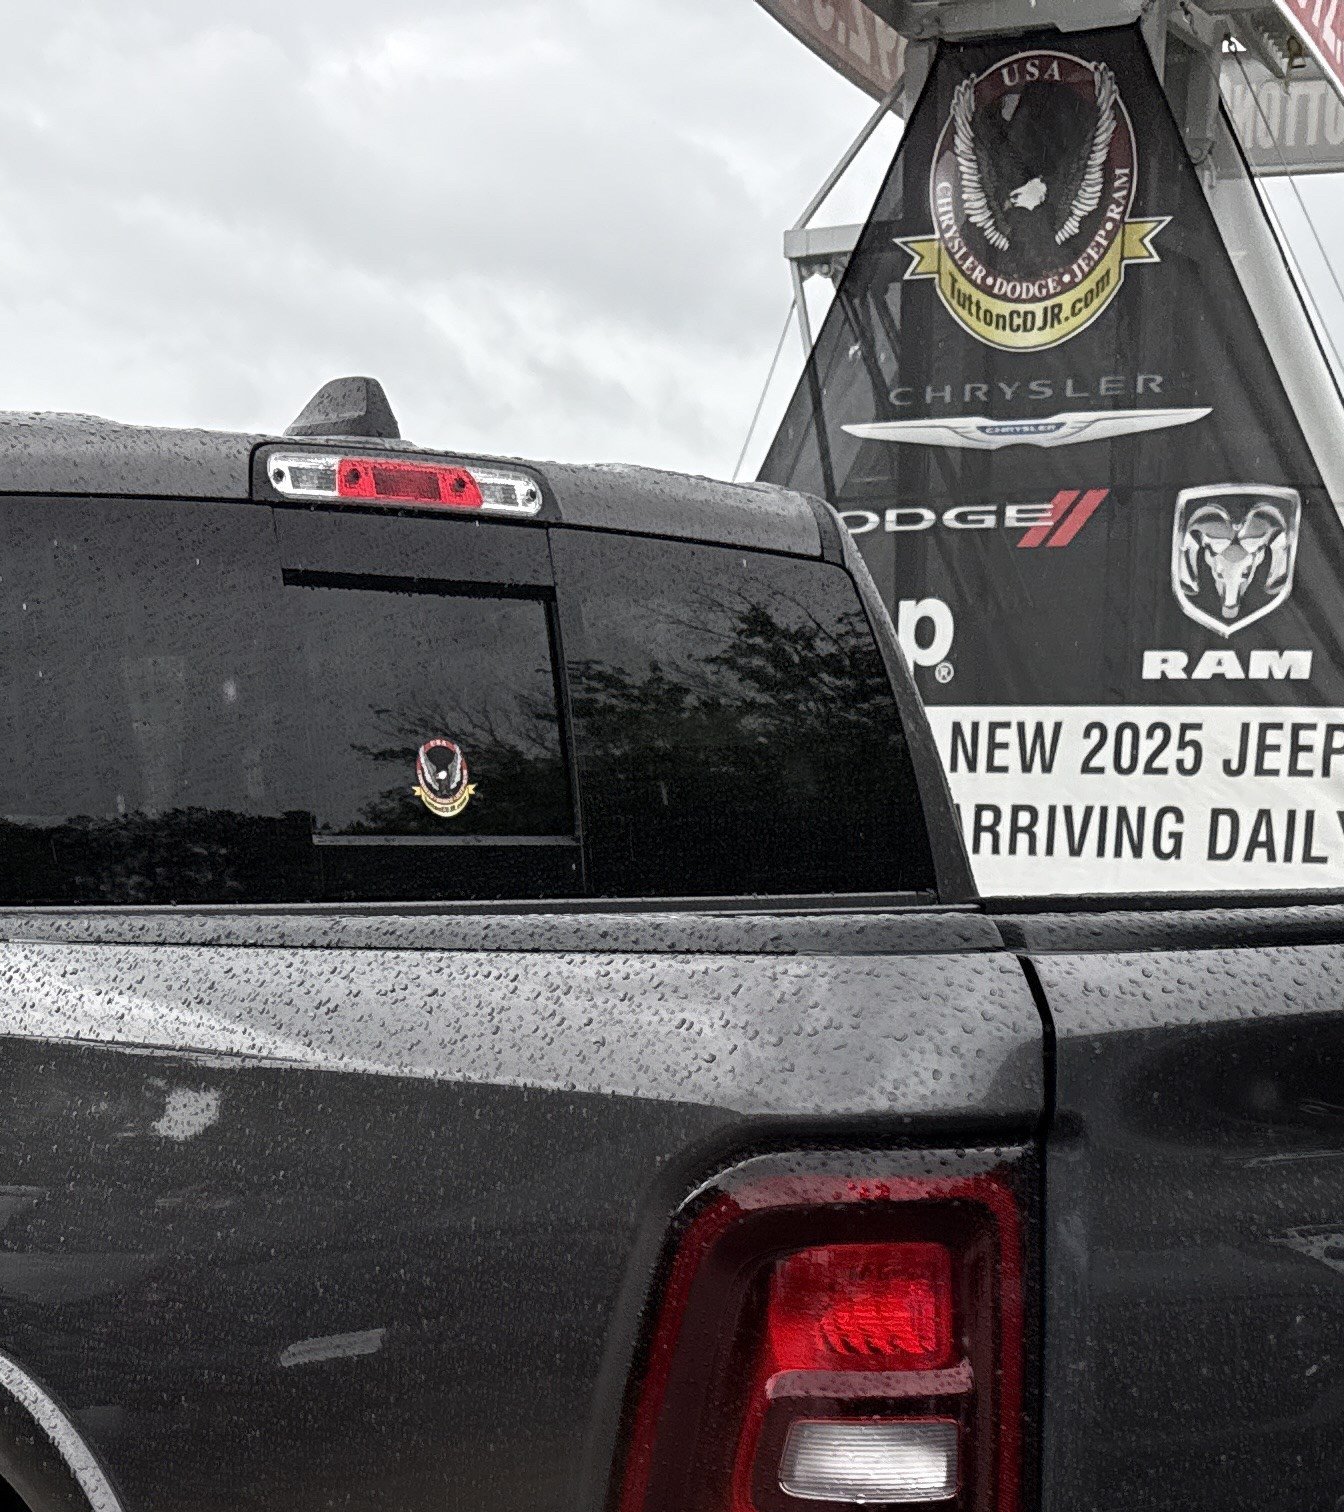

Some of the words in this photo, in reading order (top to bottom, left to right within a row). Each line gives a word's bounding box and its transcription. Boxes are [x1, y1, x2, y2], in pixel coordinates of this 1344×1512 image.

[1001, 60, 1061, 86] USA
[936, 181, 989, 285] CHRYSLER
[993, 275, 1063, 299] DODGE
[1069, 229, 1110, 283] JEEP
[1106, 167, 1131, 221] RAM
[948, 268, 1112, 333] TuttonCDJR.com
[888, 374, 1164, 406] CHRYSLER
[984, 423, 1058, 435] CHRYSLER
[838, 503, 1055, 534] ODGE
[1141, 649, 1313, 680] RAM
[949, 720, 1063, 774] NEW
[1080, 720, 1204, 777] 2025
